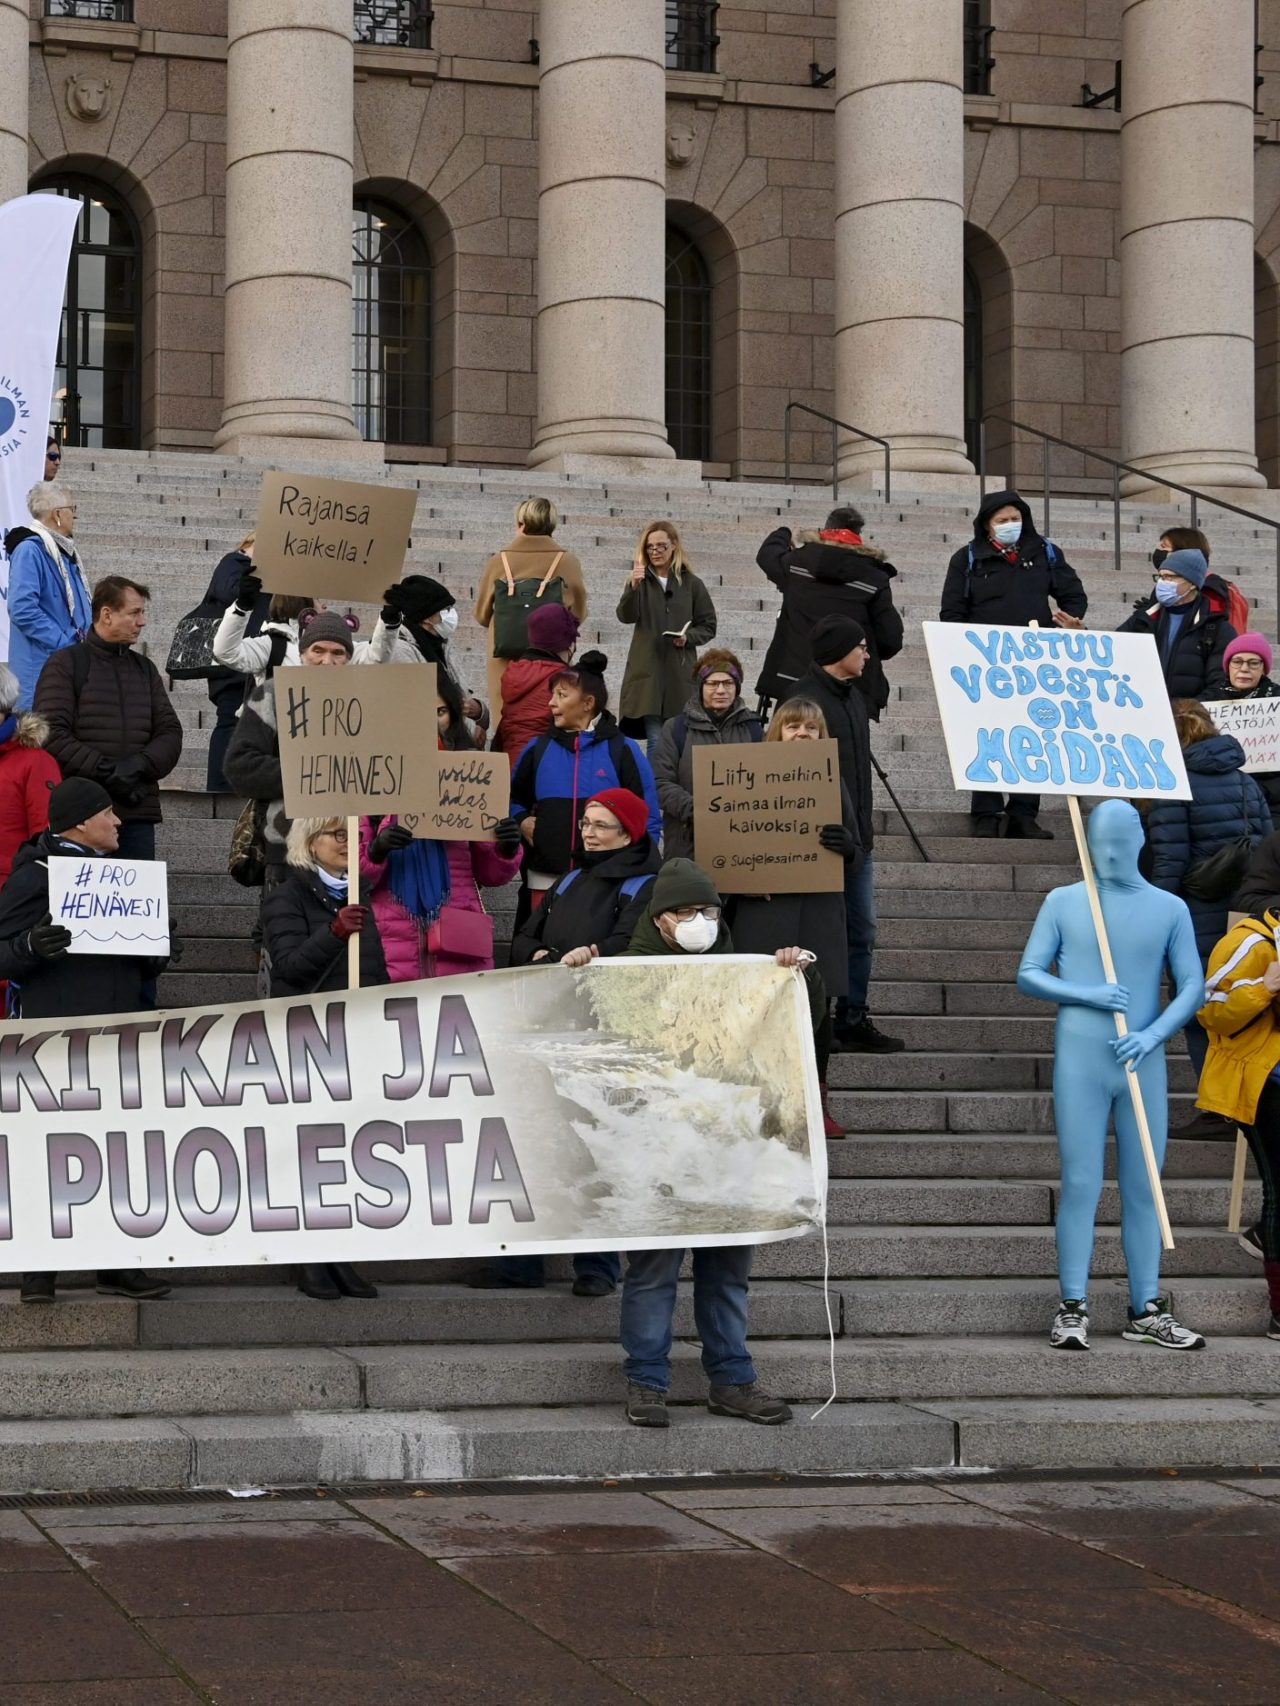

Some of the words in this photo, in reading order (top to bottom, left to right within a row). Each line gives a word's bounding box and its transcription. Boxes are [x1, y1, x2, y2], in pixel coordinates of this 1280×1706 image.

[1, 376, 30, 418] ILMAN
[279, 485, 370, 526] Rajansa
[965, 630, 1114, 667] VASTUU
[1027, 697, 1098, 730] ON
[1220, 716, 1276, 732] ÄSTÖJÄ
[300, 752, 403, 796] HEINÄVESI
[711, 760, 755, 790] Liity
[431, 810, 474, 829] vesi
[708, 796, 769, 813] Saimaa
[774, 795, 816, 811] ilman
[730, 819, 809, 835] kaivoksia
[61, 891, 161, 919] HEINÄVESI
[383, 995, 494, 1100] JA
[46, 1117, 535, 1239] PUOLESTA
